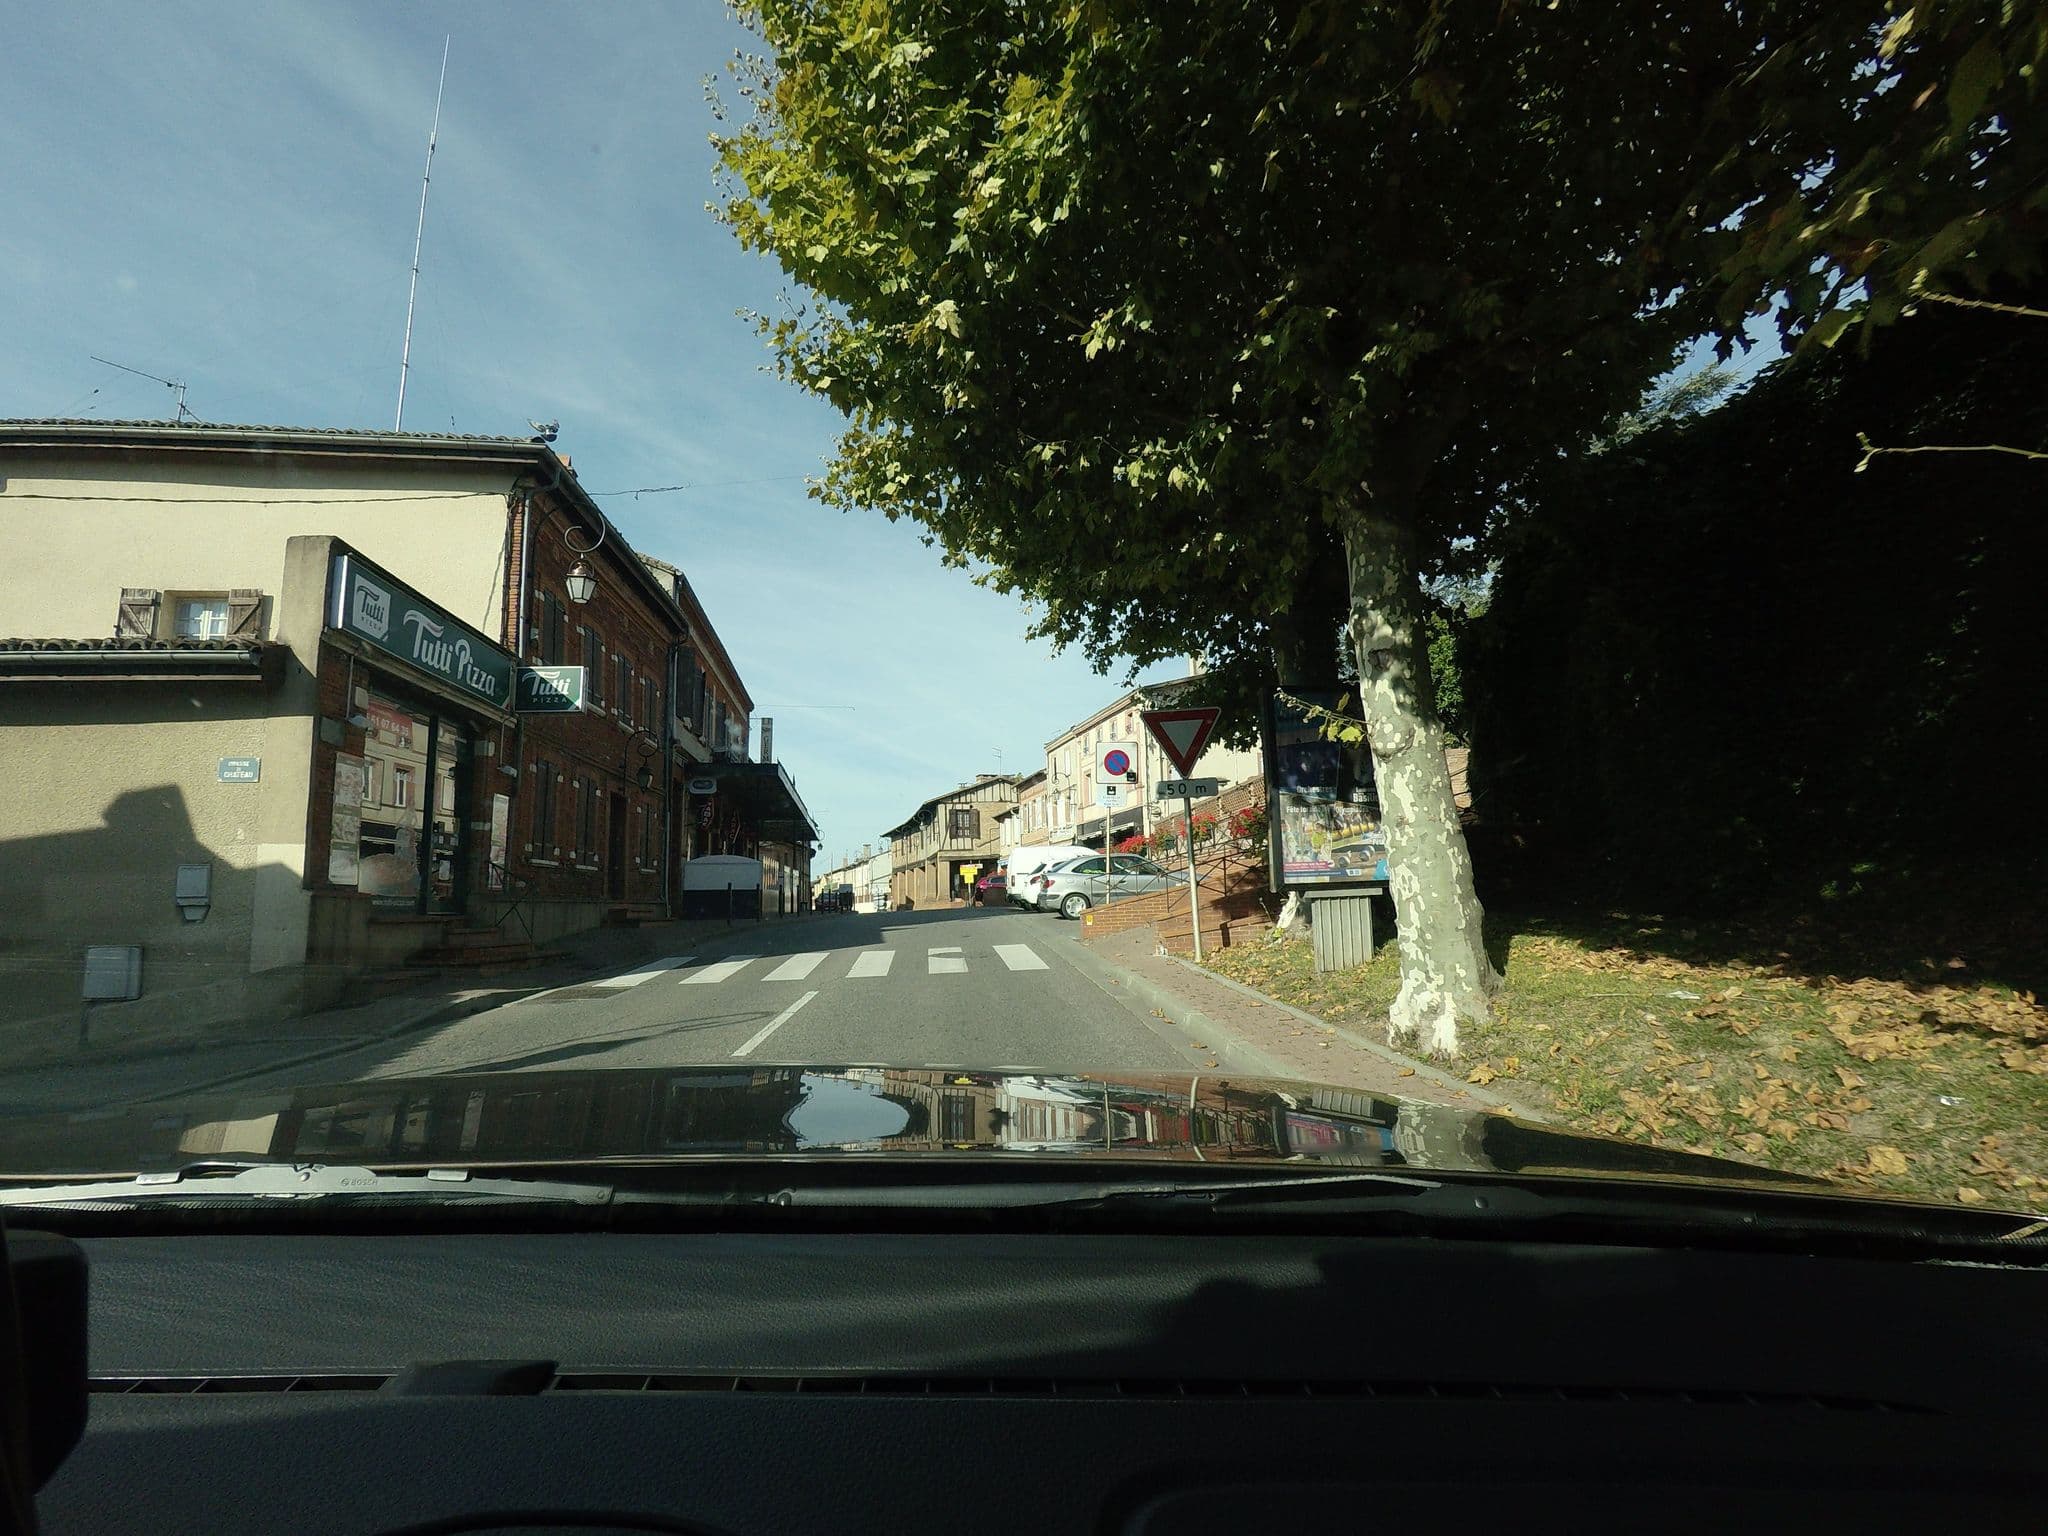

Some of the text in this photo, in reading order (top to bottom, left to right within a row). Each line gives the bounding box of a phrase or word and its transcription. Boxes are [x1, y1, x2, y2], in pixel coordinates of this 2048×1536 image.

[357, 585, 385, 623] Tutti
[403, 610, 495, 696] Tutti Pizza
[522, 671, 571, 696] Tutti
[1167, 783, 1207, 795] 50 m
